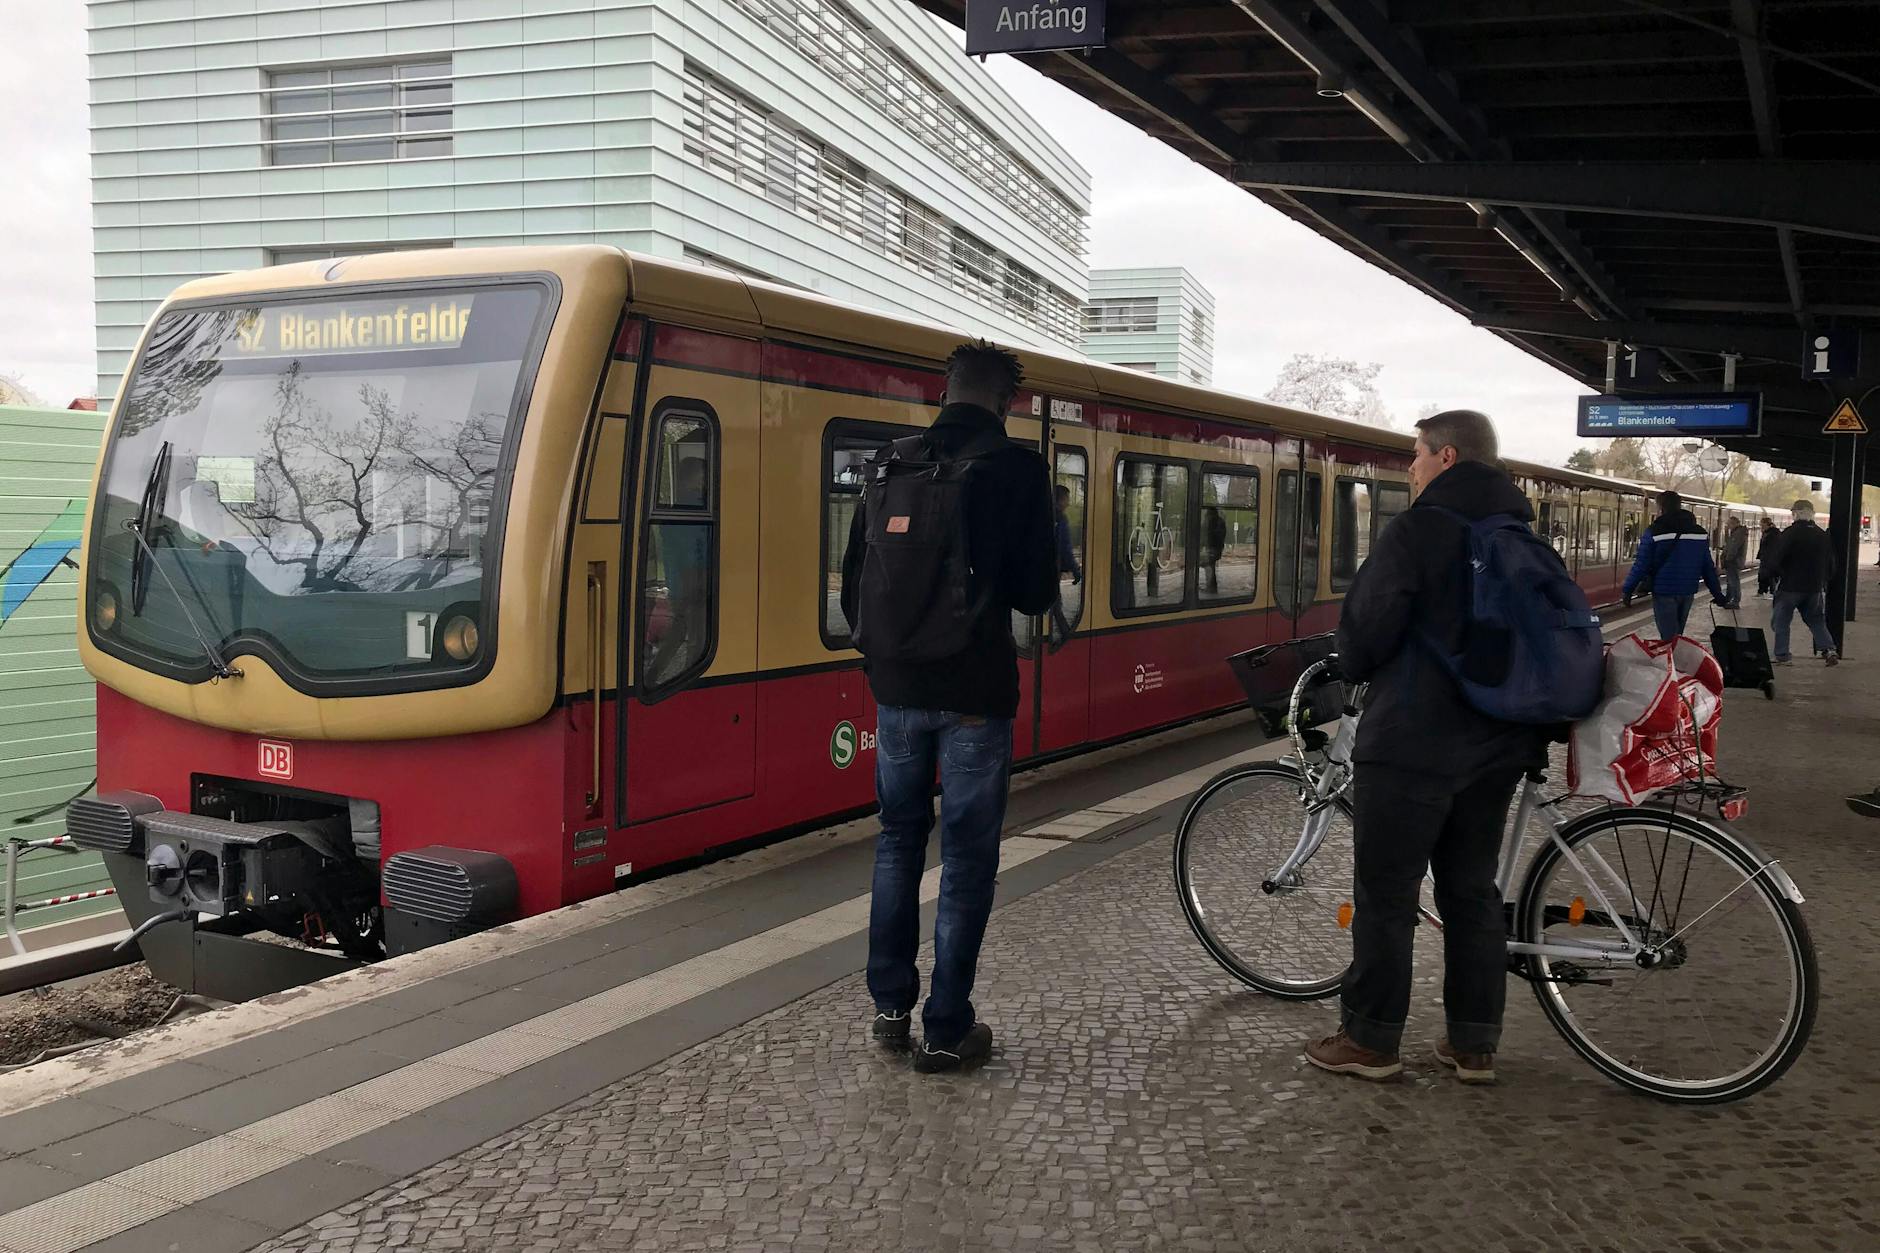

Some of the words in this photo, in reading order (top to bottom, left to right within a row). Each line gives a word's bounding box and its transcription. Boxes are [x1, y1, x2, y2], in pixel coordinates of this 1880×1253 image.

[995, 4, 1087, 33] Anfang
[236, 313, 266, 352] S2
[1624, 351, 1637, 378] 1
[1588, 406, 1600, 415] S2
[1617, 416, 1676, 425] Blankenfelde
[416, 612, 432, 655] 1
[263, 745, 289, 772] DB
[835, 726, 853, 763] S
